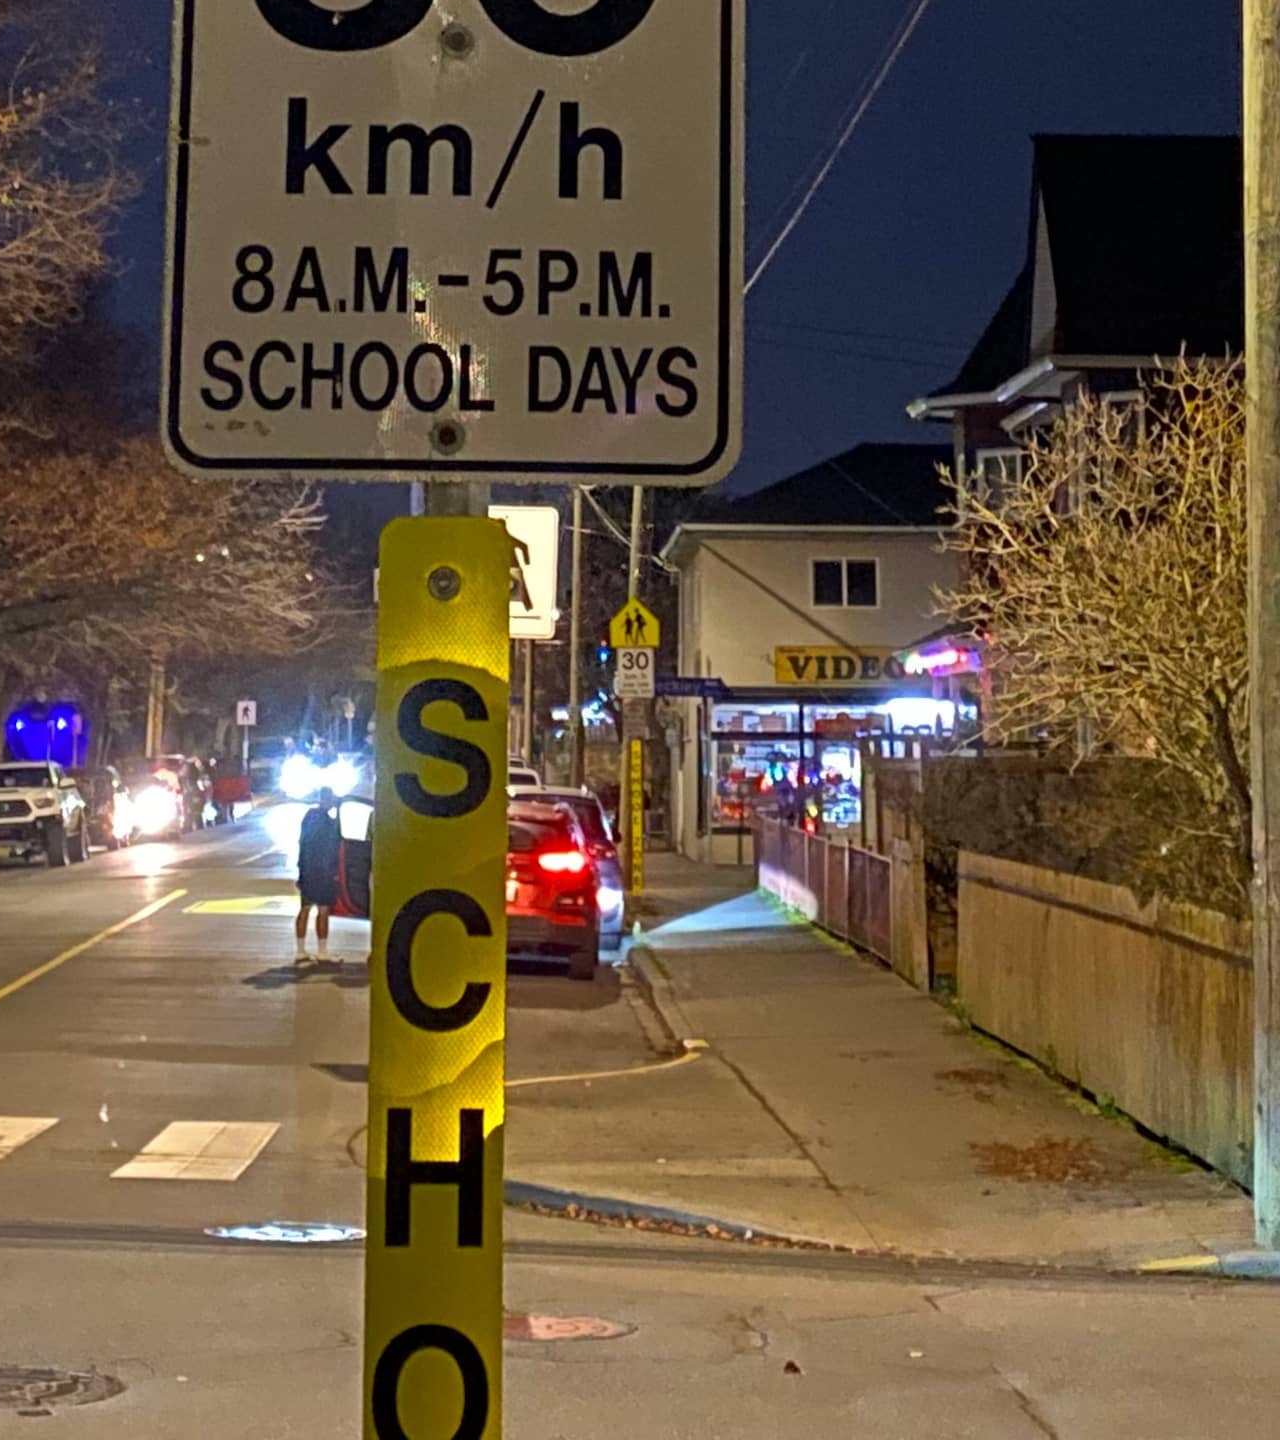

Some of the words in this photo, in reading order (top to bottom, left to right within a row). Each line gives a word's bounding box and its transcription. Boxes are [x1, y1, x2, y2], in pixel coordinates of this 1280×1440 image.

[284, 89, 623, 209] km/h
[199, 340, 495, 413] SCHOOL
[527, 345, 699, 417] DAYS
[622, 651, 649, 670] 30
